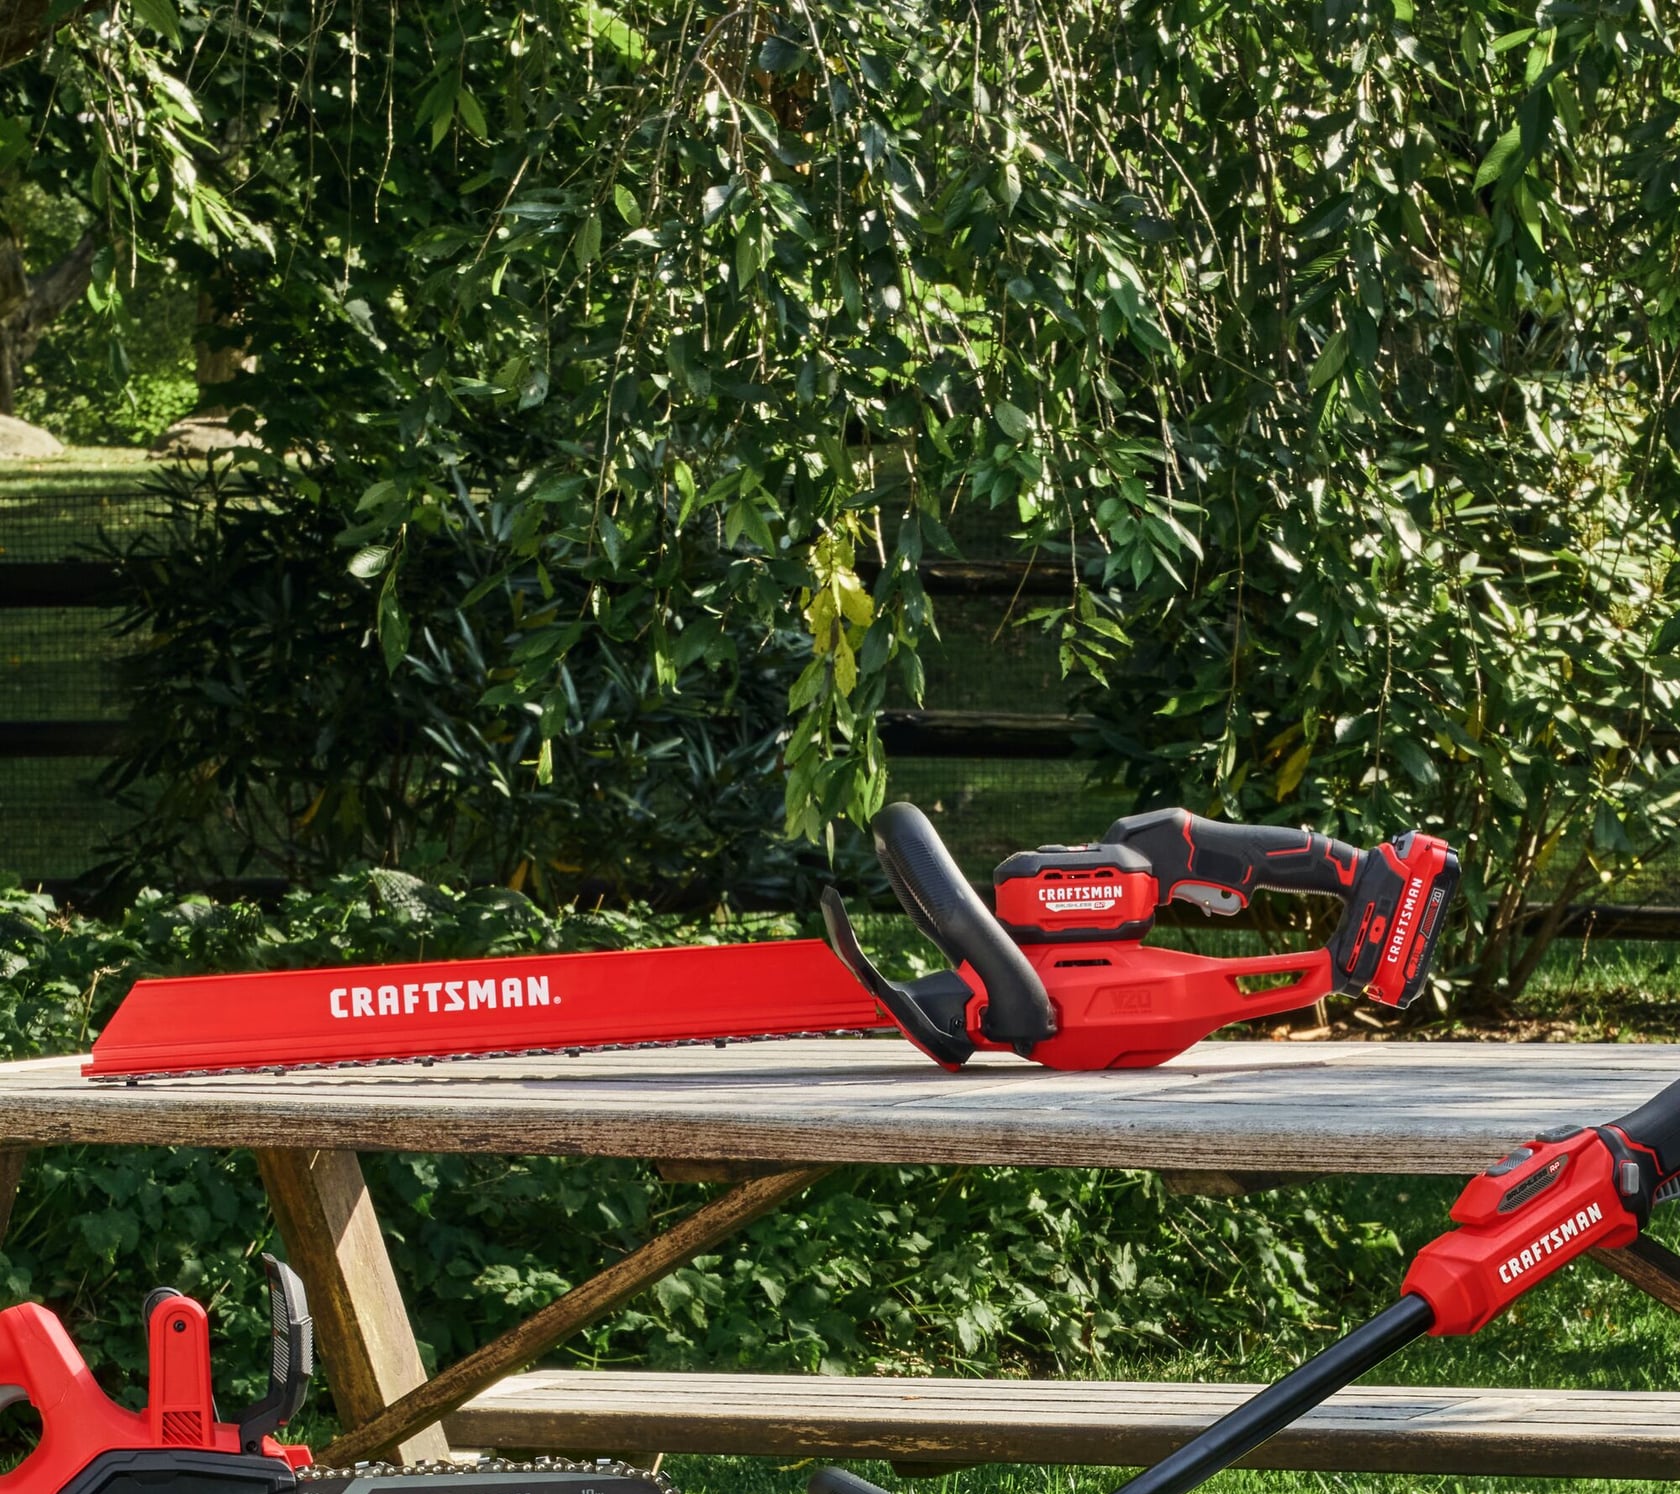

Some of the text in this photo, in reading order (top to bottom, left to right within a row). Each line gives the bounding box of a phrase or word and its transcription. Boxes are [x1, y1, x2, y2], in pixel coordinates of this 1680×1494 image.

[1038, 885, 1122, 901] CRAFTSMAN
[1387, 877, 1423, 963] CRAFTSMAN
[330, 976, 550, 1018] CRAFTSMAN
[1499, 1202, 1602, 1284] CRAFTSMAN
